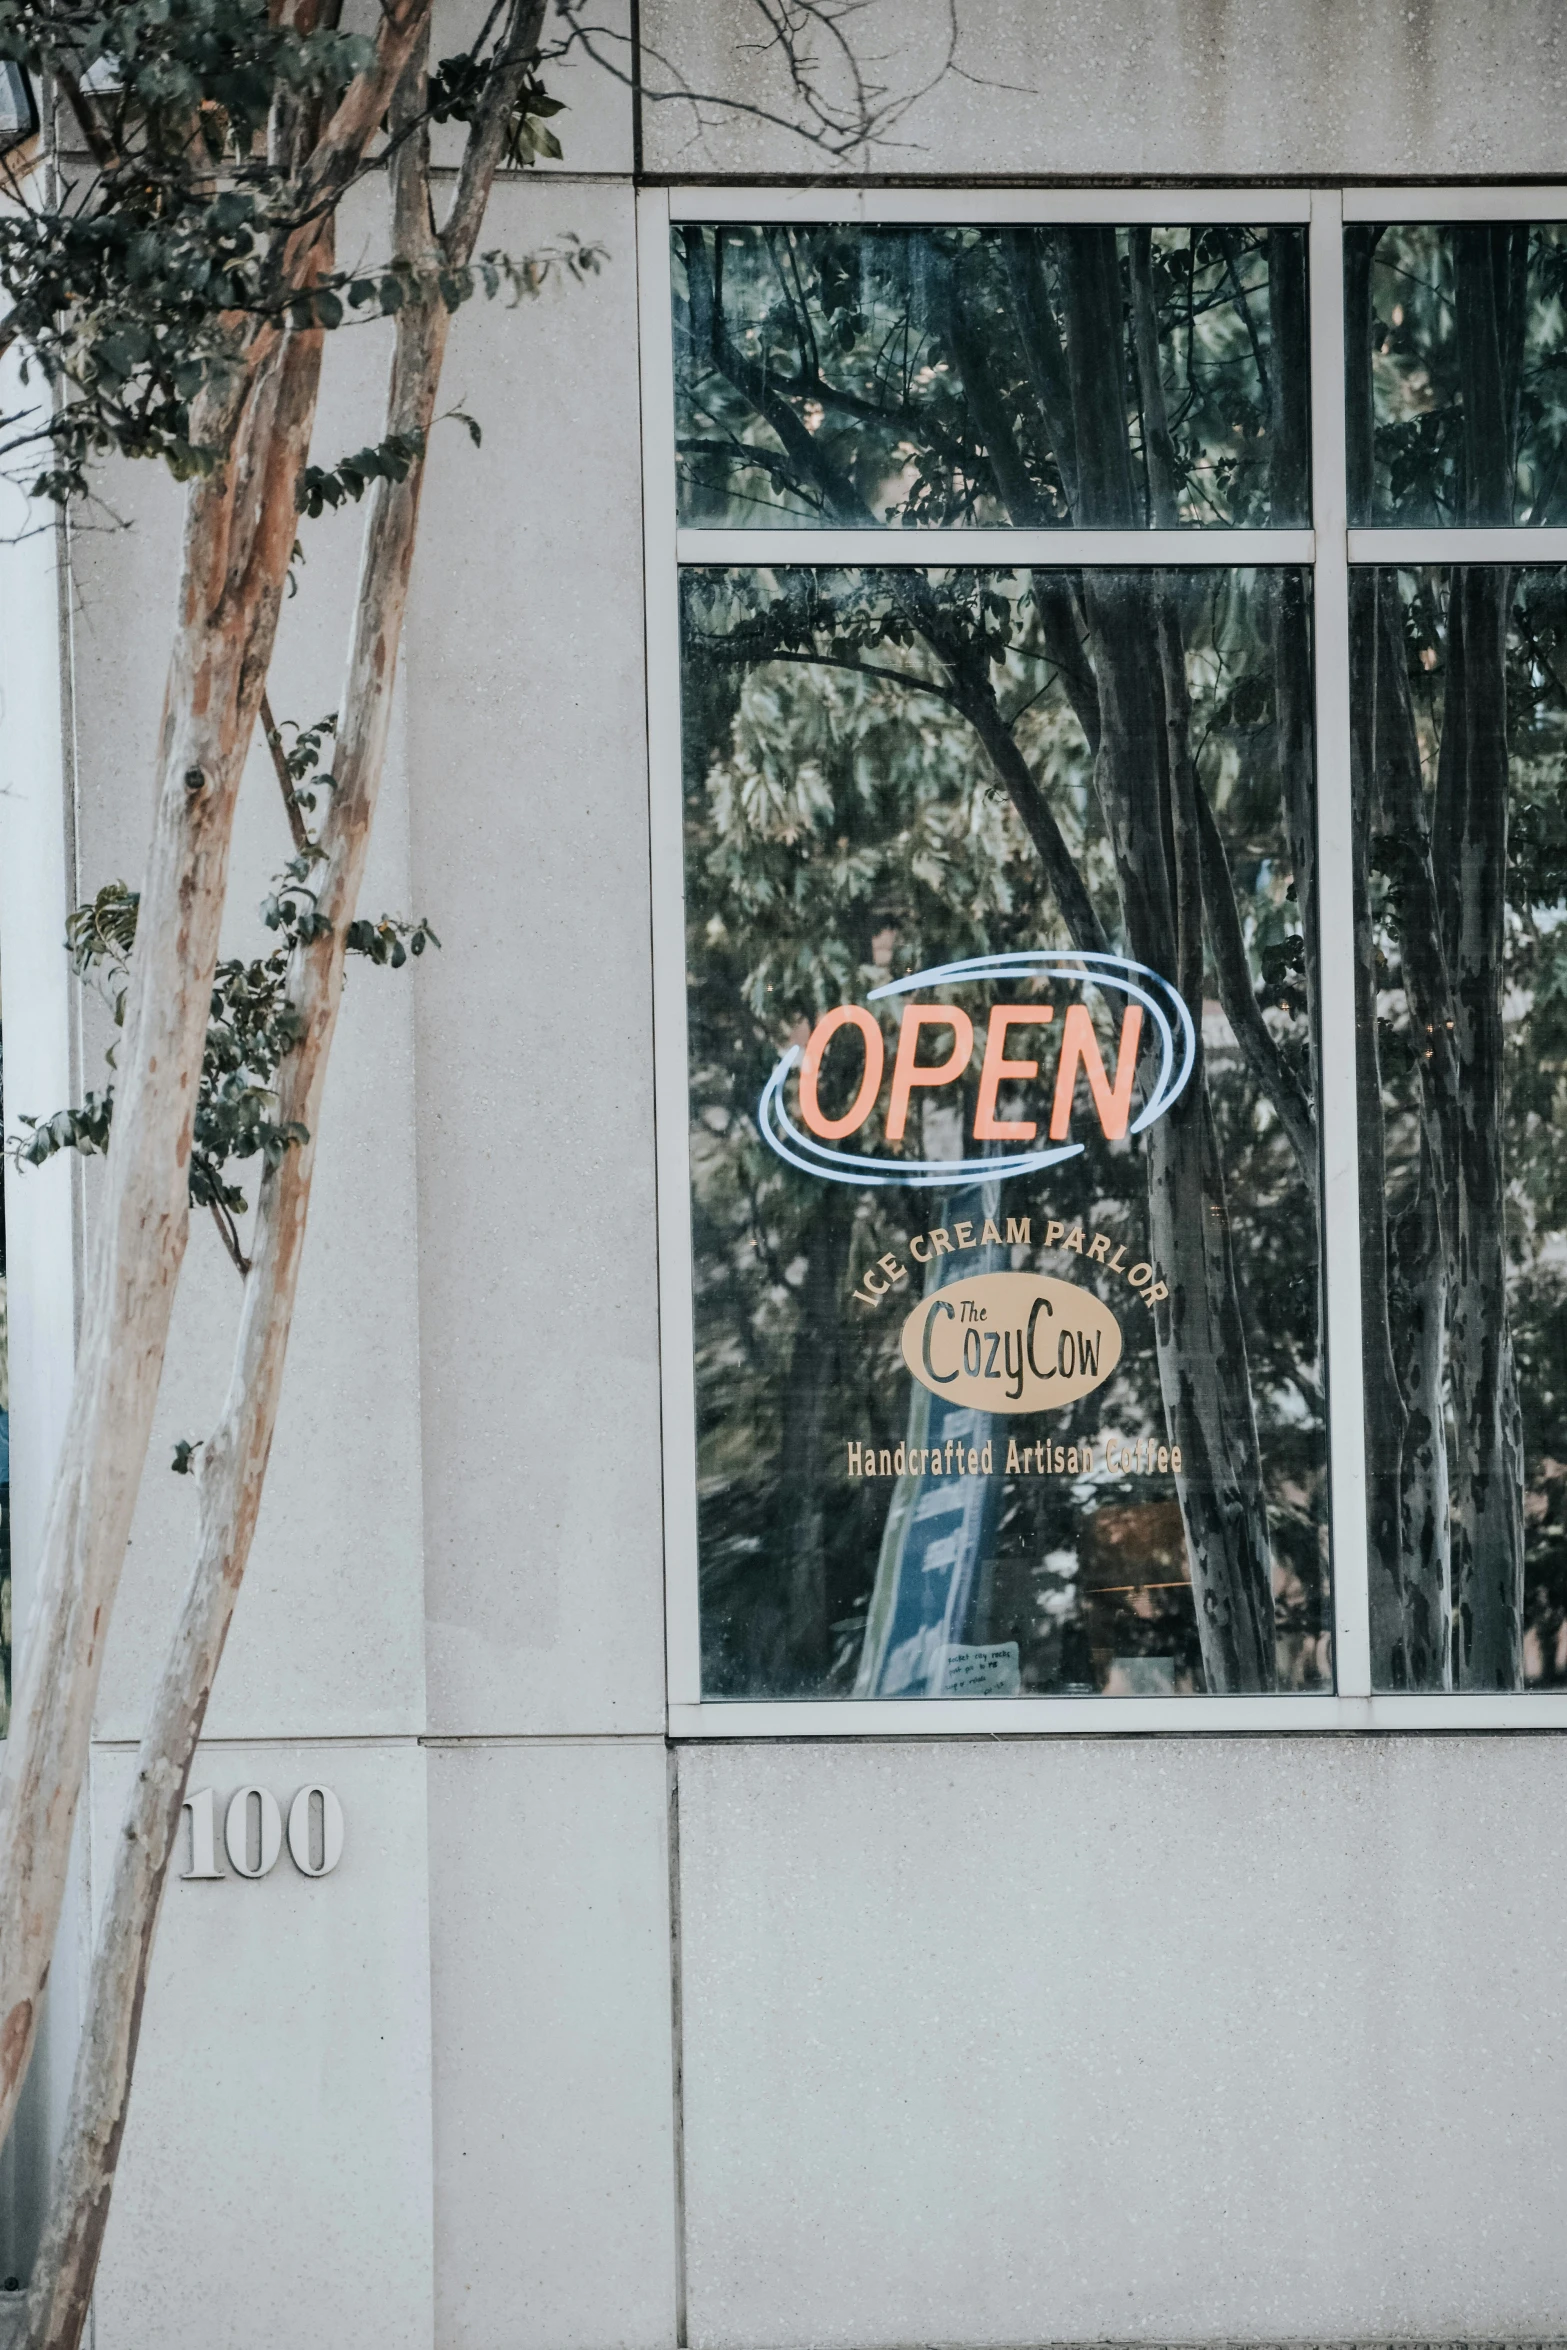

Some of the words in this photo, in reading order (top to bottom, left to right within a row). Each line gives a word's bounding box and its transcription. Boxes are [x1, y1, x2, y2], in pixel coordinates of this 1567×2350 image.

[800, 1004, 1144, 1140] OPEN
[852, 1252, 908, 1308] ICE
[909, 1217, 1032, 1263] CREAM
[1044, 1220, 1169, 1308] PARLOR
[960, 1300, 988, 1323] The
[847, 1440, 994, 1477] Handcrafted
[1004, 1438, 1094, 1475] Artisan
[1106, 1438, 1183, 1474] Coffee
[180, 1784, 345, 1879] 100
